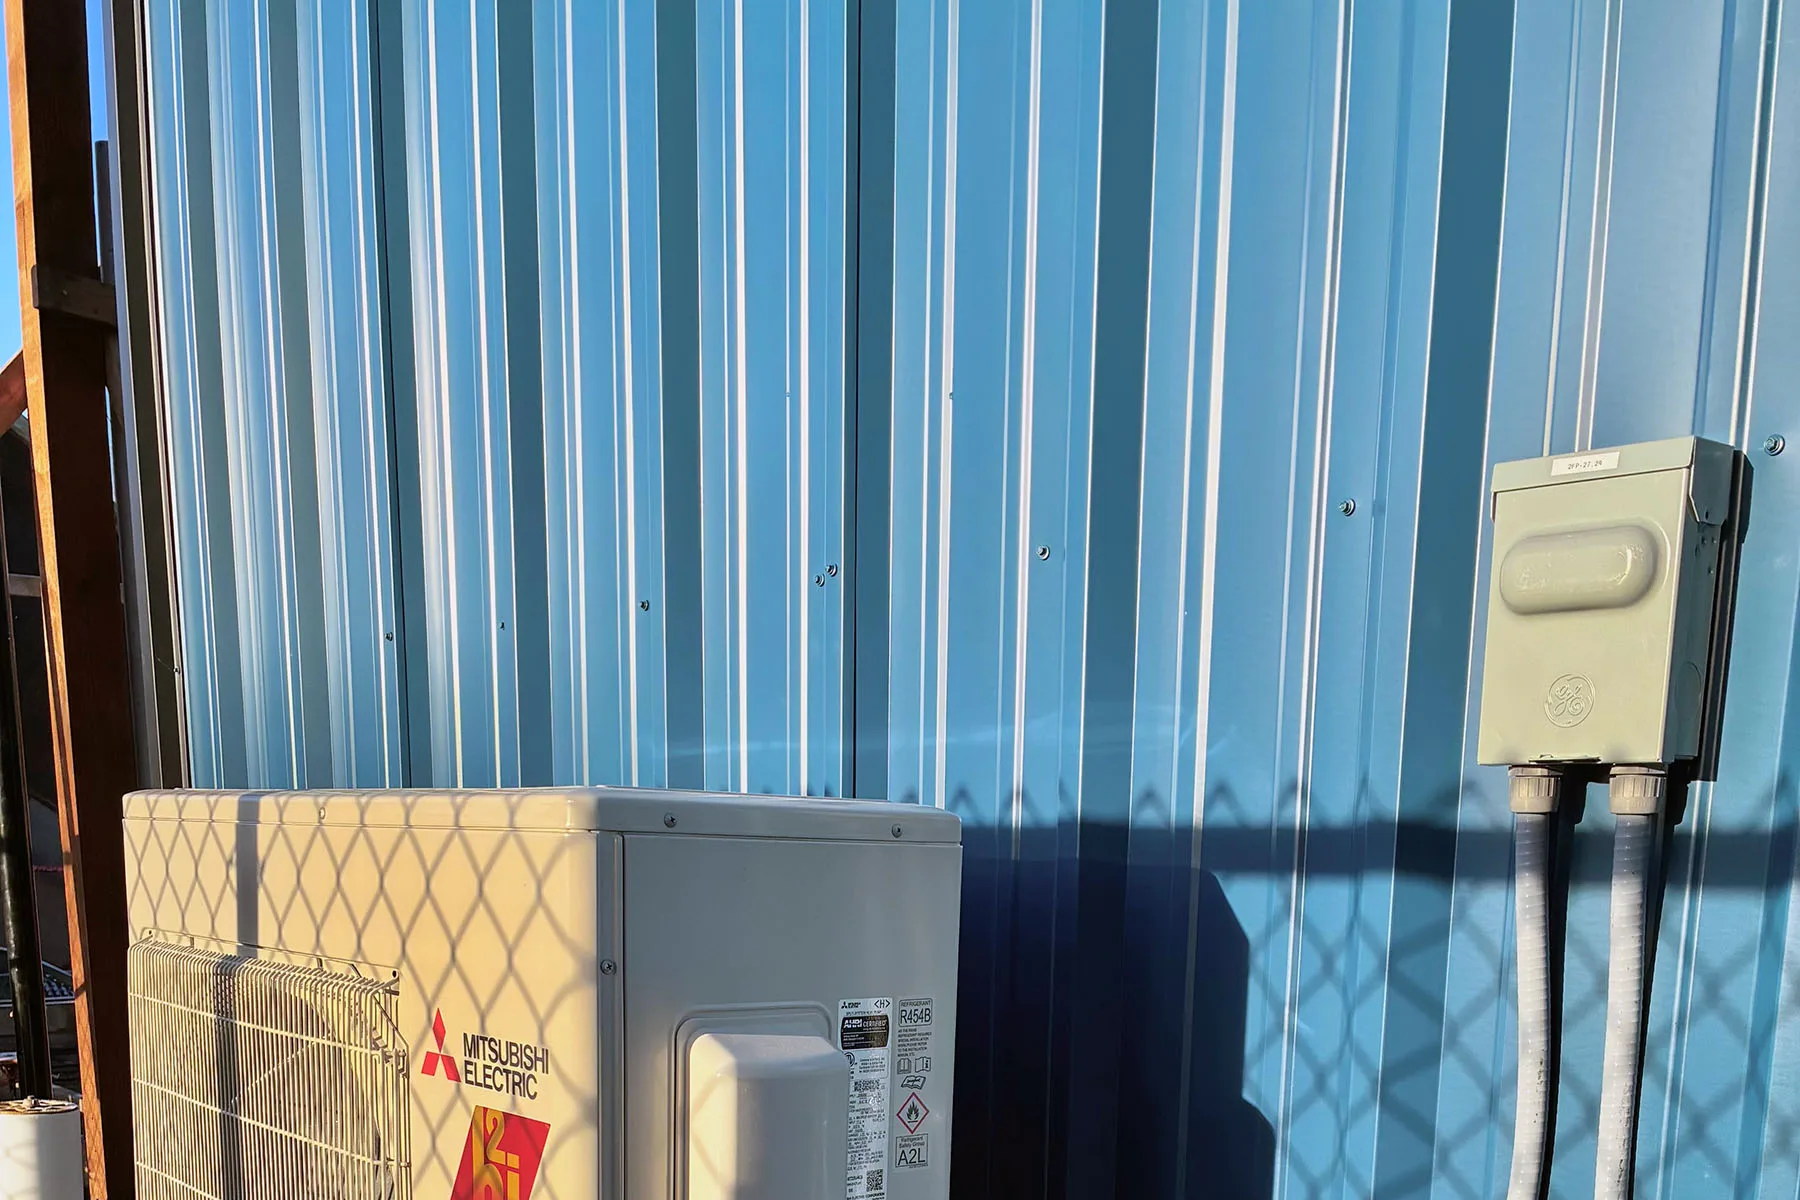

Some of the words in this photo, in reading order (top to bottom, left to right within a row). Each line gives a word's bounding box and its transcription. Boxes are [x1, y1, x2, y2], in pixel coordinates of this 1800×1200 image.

[900, 1008, 931, 1024] R454B
[463, 1032, 549, 1075] MITSUBISHI
[464, 1060, 538, 1101] ELECTRIC
[898, 1148, 925, 1166] A2L
